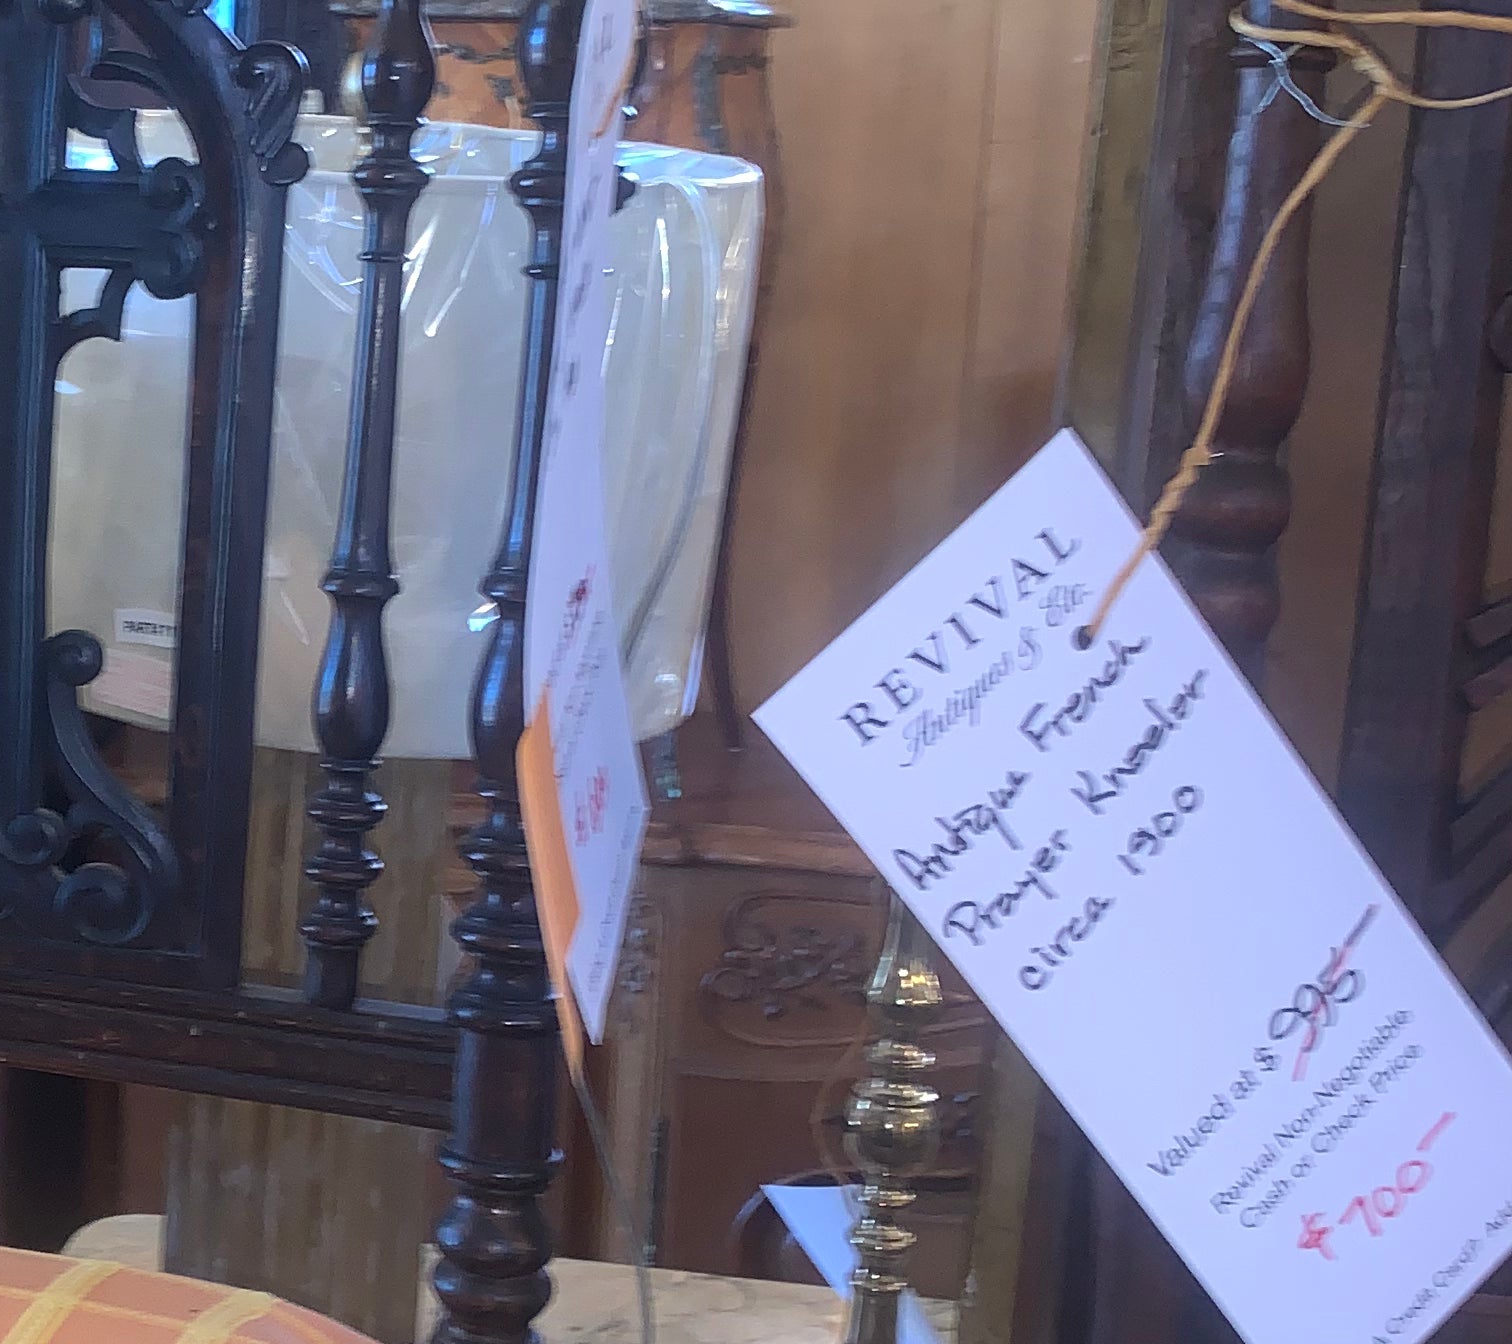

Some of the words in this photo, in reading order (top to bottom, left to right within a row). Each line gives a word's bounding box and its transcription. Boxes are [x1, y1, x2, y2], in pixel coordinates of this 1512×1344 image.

[838, 527, 1082, 746] REVIVAL
[899, 651, 1015, 768] Antiques
[893, 770, 1034, 891] Antique
[1018, 636, 1153, 753] French
[943, 828, 1072, 946] Prayer
[1070, 668, 1210, 816] Kneeler
[1018, 896, 1118, 992] circa
[1117, 784, 1205, 876] 1900
[1146, 1093, 1236, 1178] Valued
[1229, 1070, 1262, 1100] at
[1209, 1143, 1280, 1215] Revival
[1273, 1009, 1416, 1149] Non-Negotiable
[1239, 1178, 1297, 1229] Cash
[1290, 1154, 1317, 1179] or
[1309, 1092, 1379, 1154] Check
[1367, 1043, 1425, 1095] Price
